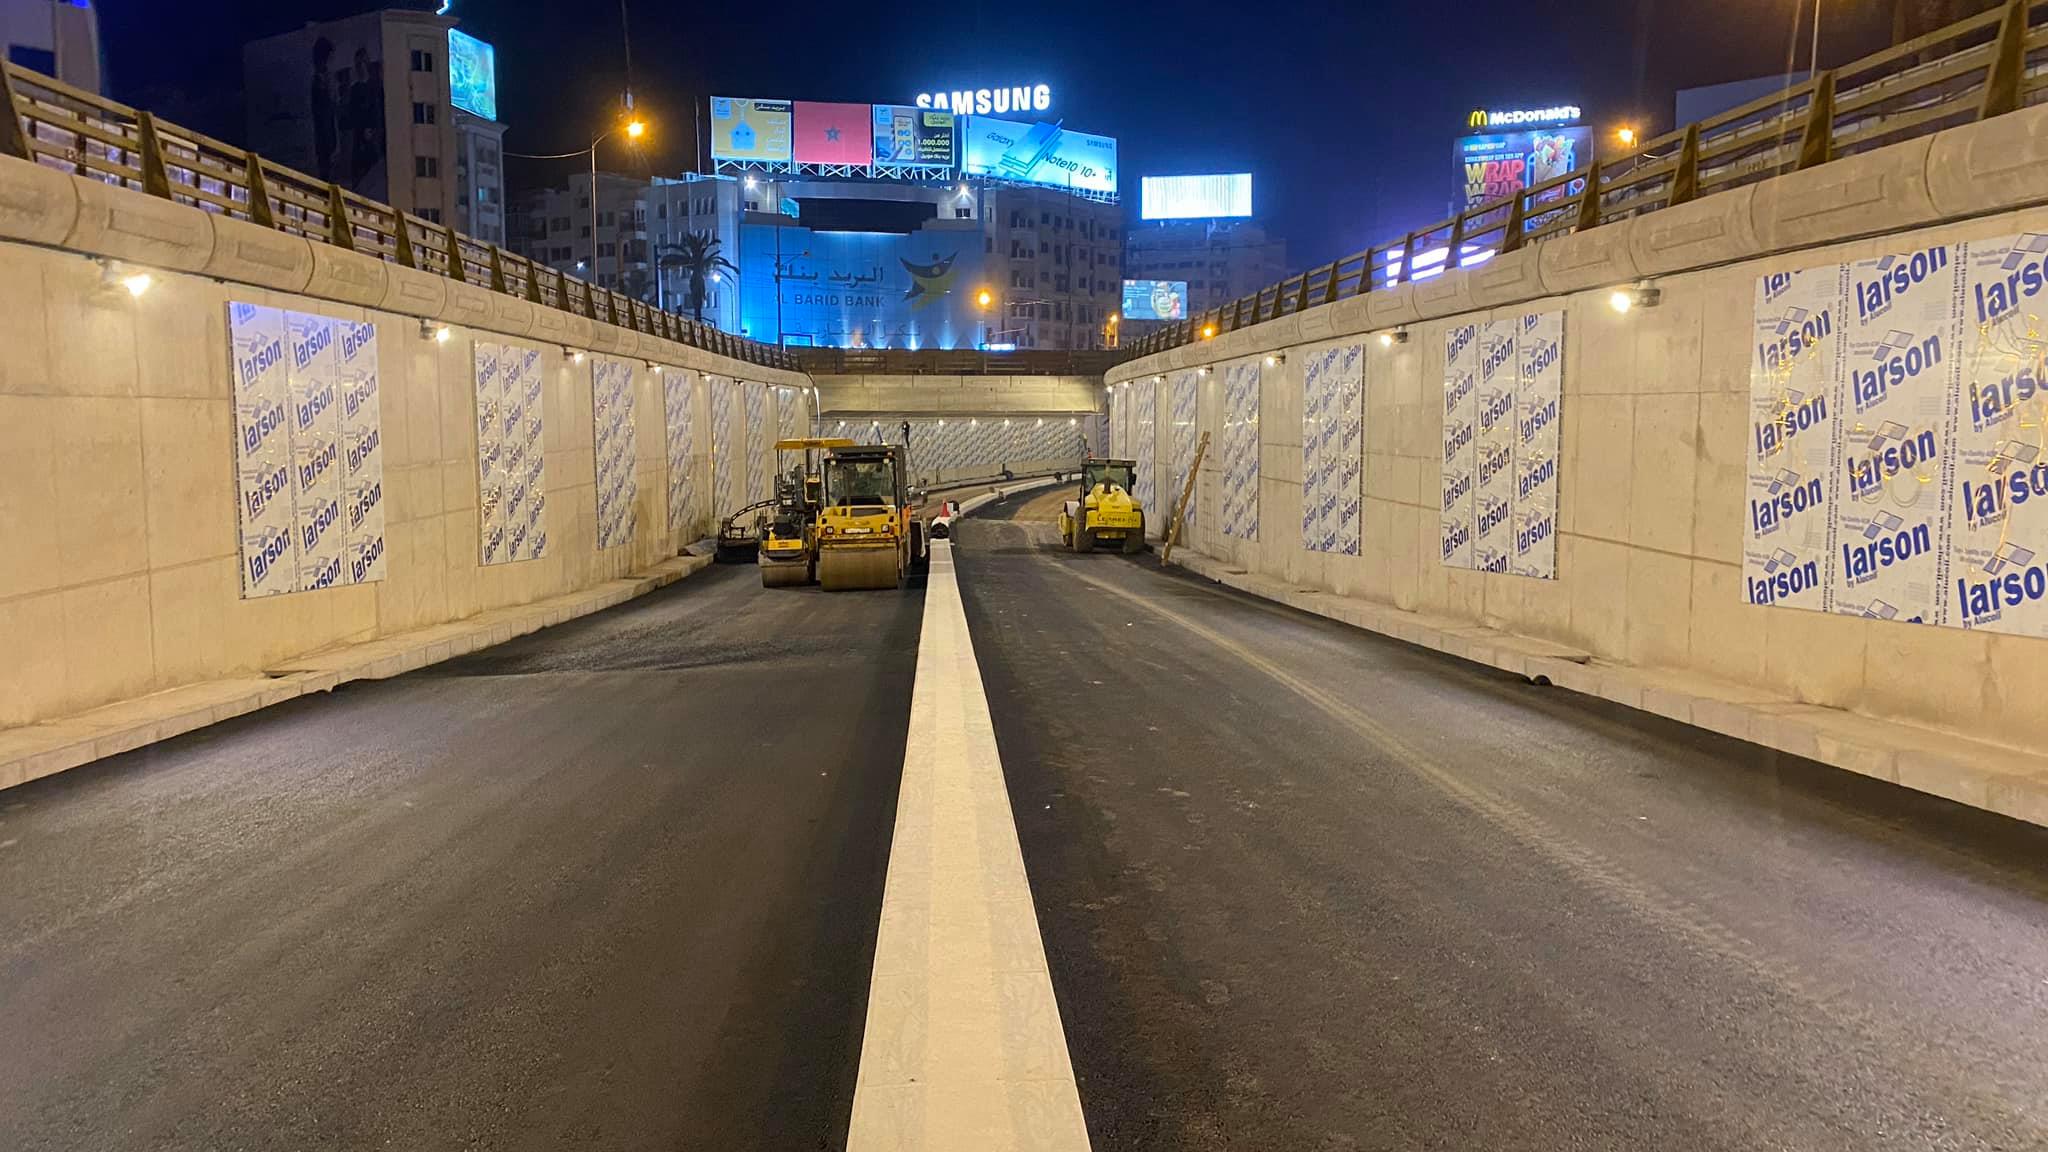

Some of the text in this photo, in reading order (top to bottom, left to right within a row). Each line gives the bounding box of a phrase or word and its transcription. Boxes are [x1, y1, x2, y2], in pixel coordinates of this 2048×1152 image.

[916, 84, 1051, 116] SAMSUNG
[1489, 105, 1581, 126] McDonald's
[1043, 152, 1079, 172] Note10
[1464, 159, 1525, 185] WRAP
[828, 266, 884, 289] البريد
[1856, 246, 1948, 317] larson
[1974, 255, 2048, 324] lars
[794, 293, 840, 306] BARID
[844, 295, 887, 308] BANK
[293, 326, 331, 367] larson
[342, 323, 375, 358] larson
[1447, 325, 1475, 361] larson
[1482, 338, 1514, 379] larson
[239, 340, 282, 386] larson
[1852, 335, 1942, 405] larson
[296, 385, 334, 428] larson
[344, 375, 377, 415] larson
[1446, 374, 1473, 411] larson
[1481, 393, 1512, 430] larson
[242, 404, 285, 451] larson
[1445, 424, 1472, 460] larson
[1520, 401, 1556, 442] larson
[1755, 394, 1827, 453] larson
[299, 442, 336, 488] larson
[347, 429, 379, 471] larson
[1479, 447, 1510, 483] larson
[1848, 430, 1936, 493] larson
[245, 466, 288, 516] larson
[1443, 475, 1470, 508] larson
[1518, 459, 1554, 497] larson
[302, 500, 339, 549] larson
[350, 483, 382, 527] larson
[1478, 502, 1509, 535] larson
[1751, 478, 1823, 531] larson
[249, 528, 291, 582] larson
[1442, 527, 1469, 556] larson
[1516, 517, 1552, 553] larson
[1843, 523, 1931, 579] larson
[351, 537, 384, 582] larson
[1747, 560, 1818, 605] larson
[1957, 563, 2048, 619] larso
